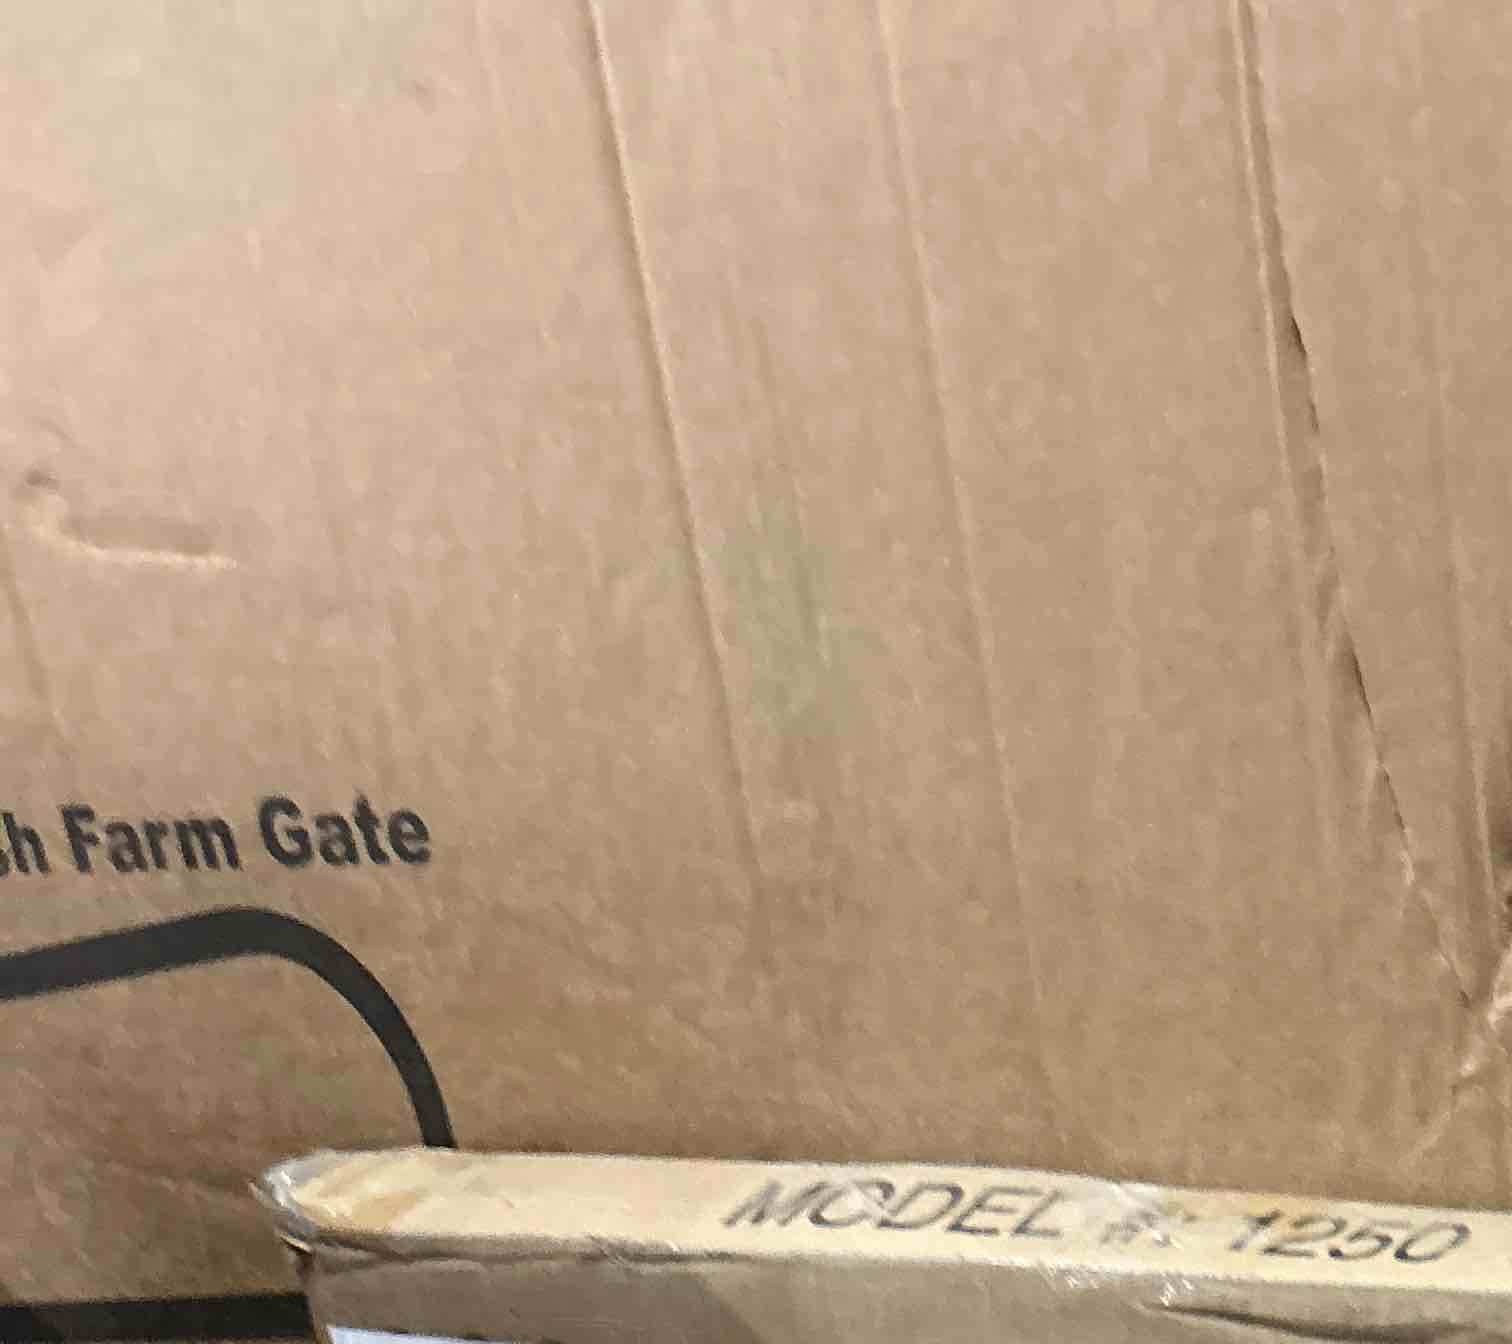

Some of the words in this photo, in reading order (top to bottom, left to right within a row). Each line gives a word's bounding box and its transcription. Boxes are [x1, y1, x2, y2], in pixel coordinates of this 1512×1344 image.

[58, 803, 243, 873] Farm
[258, 793, 432, 867] Gate
[723, 1179, 1065, 1238] MODEL
[1229, 1210, 1471, 1263] 1250
